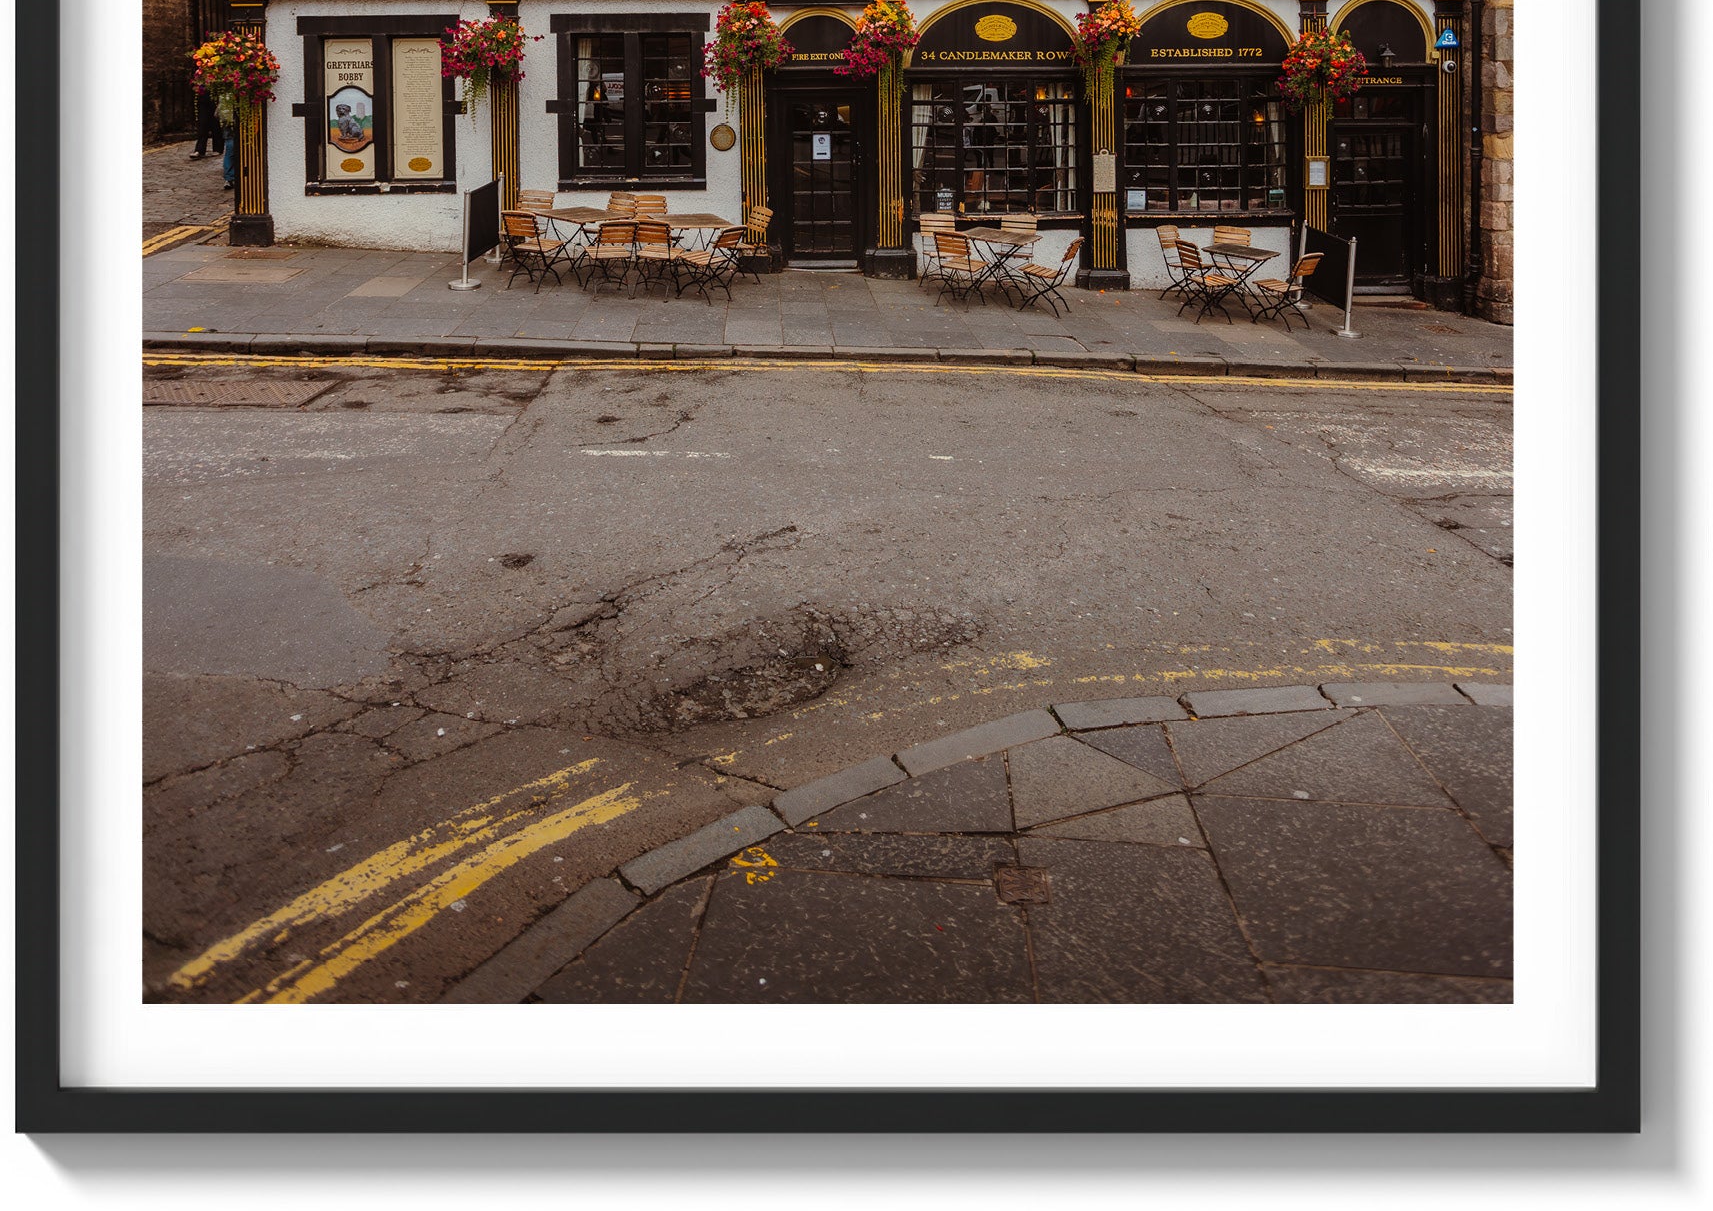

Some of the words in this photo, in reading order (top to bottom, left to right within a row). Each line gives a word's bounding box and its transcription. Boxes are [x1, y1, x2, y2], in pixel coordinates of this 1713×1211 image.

[921, 51, 935, 60] 34
[939, 51, 1032, 60] CANDLEMAKER
[1037, 51, 1069, 60] ROW
[1151, 48, 1233, 58] ESTABLISHED
[1238, 48, 1263, 57] 1772
[338, 72, 364, 82] BOBBY
